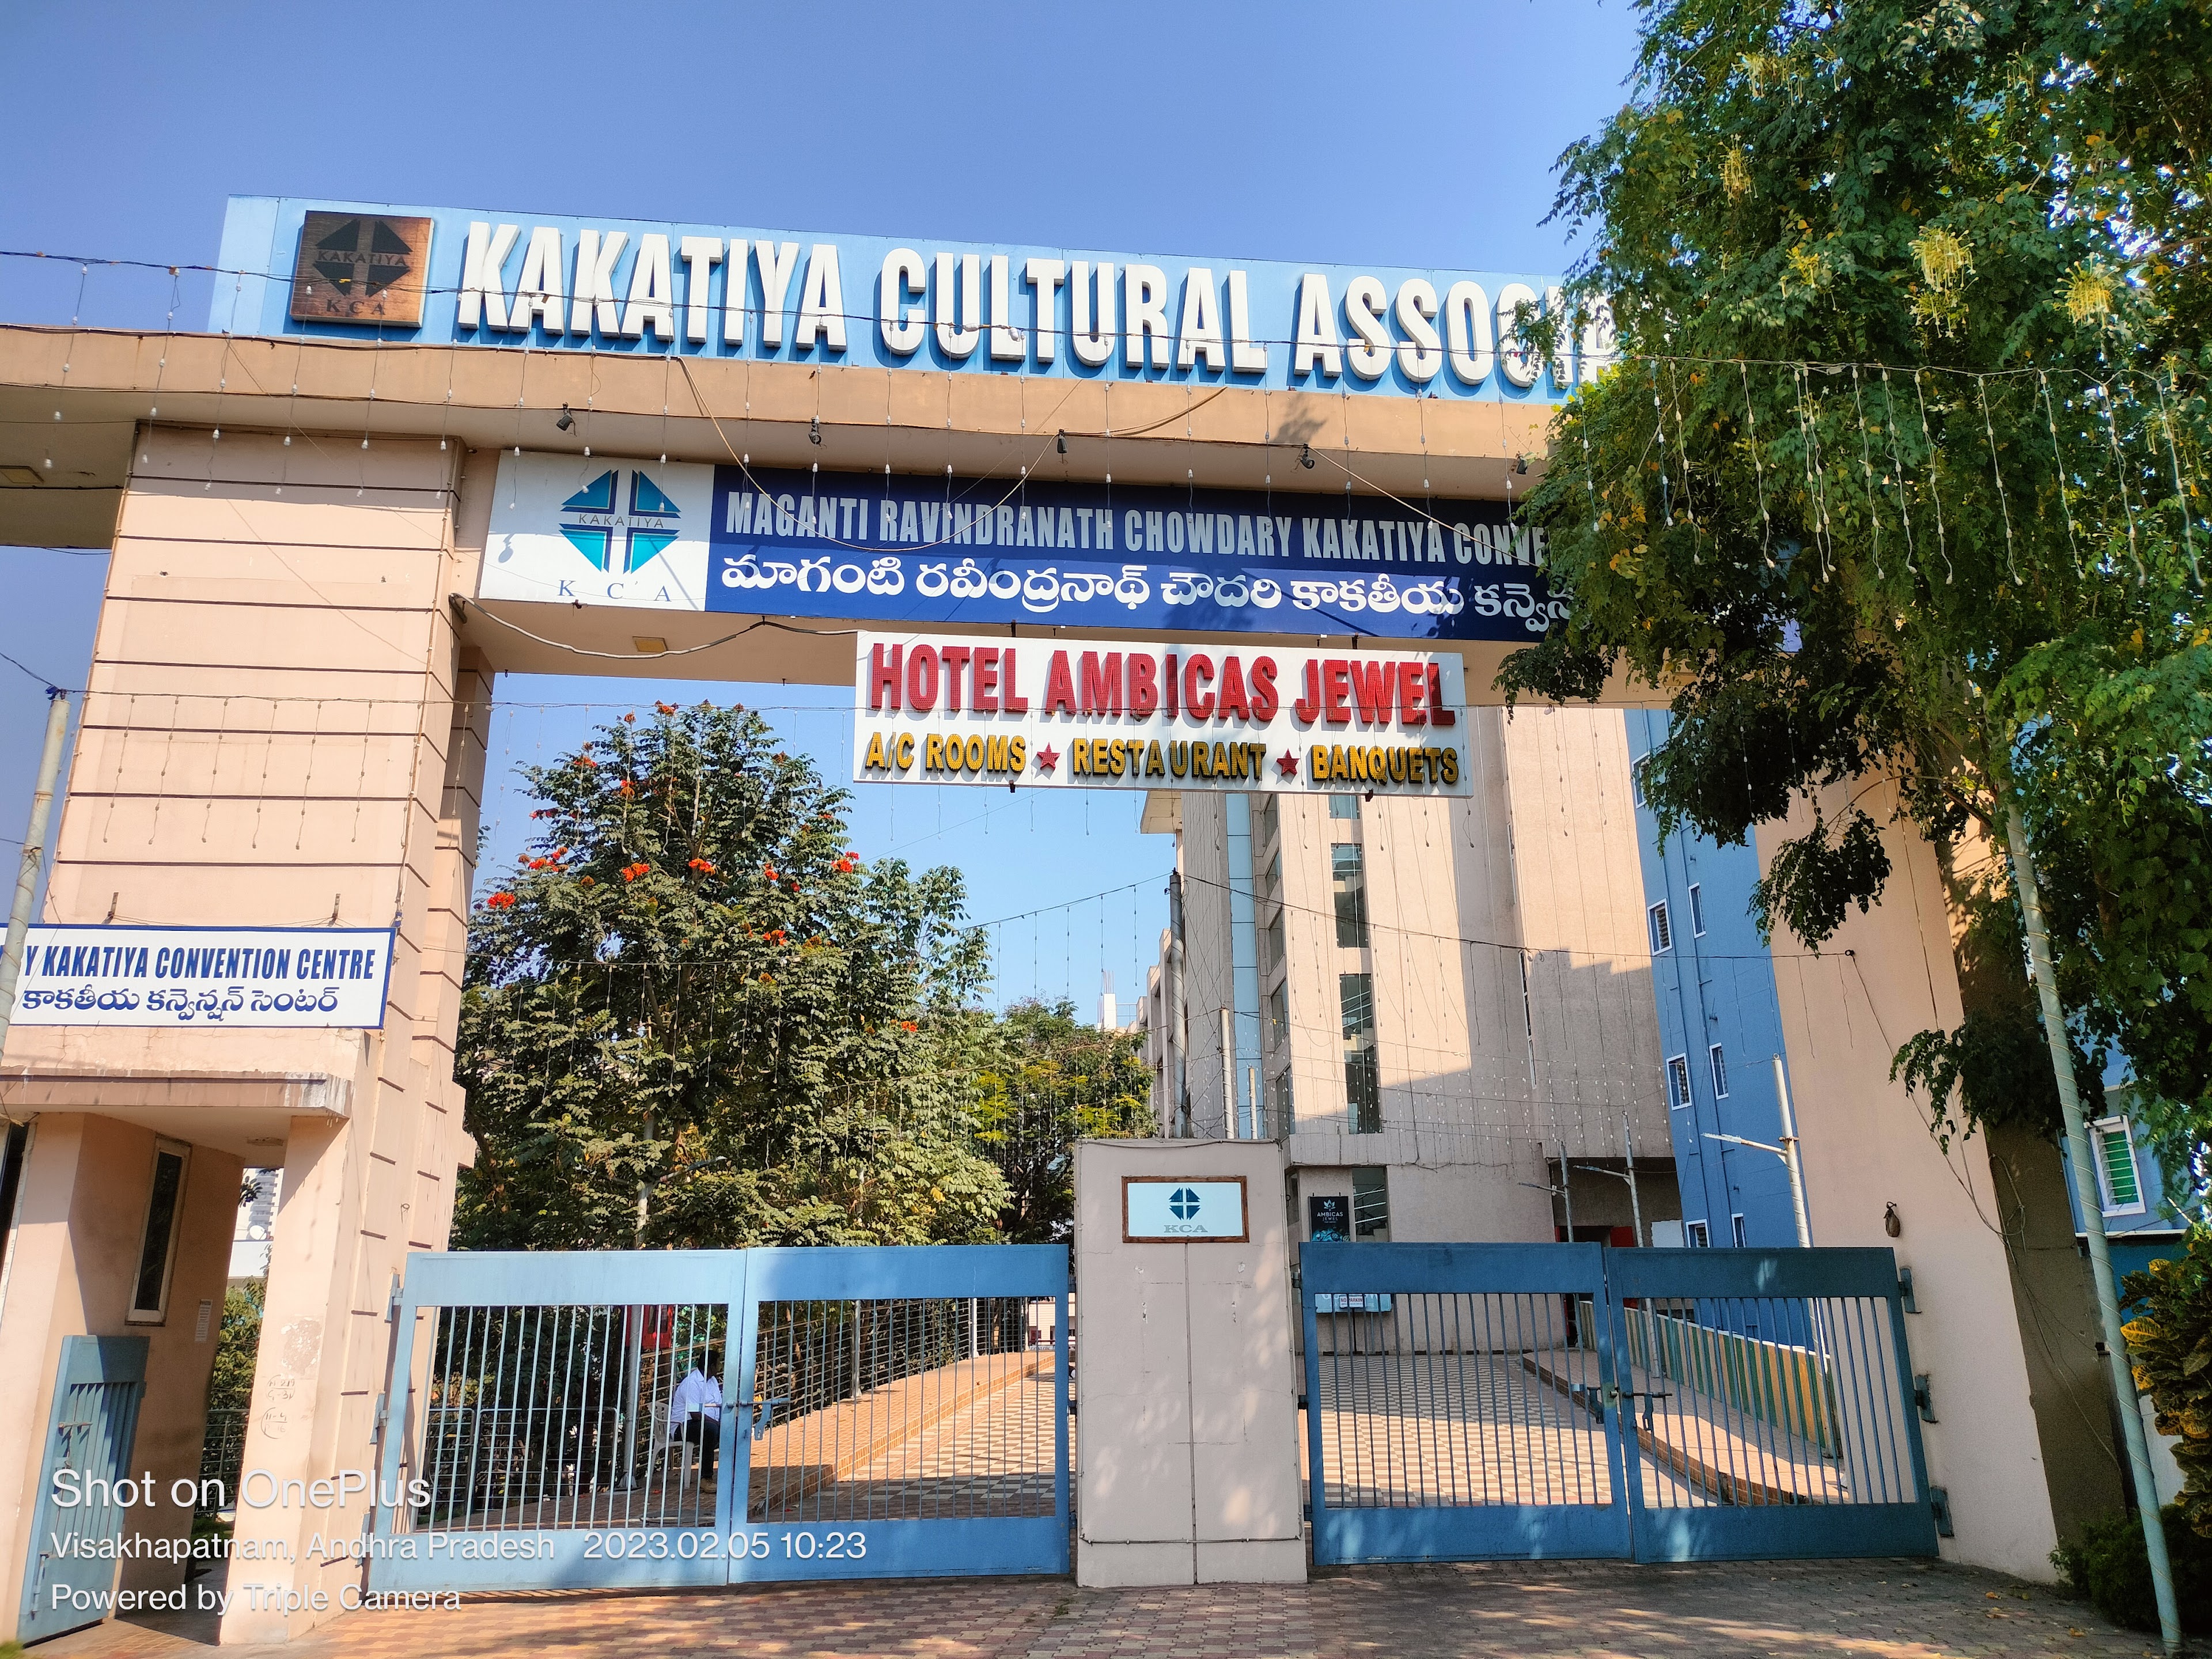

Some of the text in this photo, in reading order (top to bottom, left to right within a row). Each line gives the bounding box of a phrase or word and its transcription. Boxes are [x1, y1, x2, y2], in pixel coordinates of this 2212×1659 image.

[317, 250, 409, 268] KAKATIYA
[459, 221, 1622, 388] KAKATIYA CULTURAL ASSOCIA
[578, 513, 664, 529] KAKATIYA
[726, 491, 1553, 567] MAGANTI RAVINDRANATH CHOWDARY KAKATIYA CONVE
[722, 554, 905, 596] మాగంటి
[916, 556, 1150, 613] రవీంద్రనాథ్
[1160, 571, 1283, 609] చౌదరి
[1290, 572, 1465, 615] కాకతీయ
[870, 642, 1456, 726] HOTEL AMBICAS JEWEL
[865, 732, 1459, 785] A/C ROOMS RESTAURANT BANQUETS
[41, 946, 147, 978] KAKATIYA
[155, 946, 290, 979] CONVENTION
[297, 948, 376, 979] CENTRE
[22, 984, 340, 1021] కాకతీయ కన్వెన్షన్ సెంటర్
[1164, 1225, 1208, 1233] KCA
